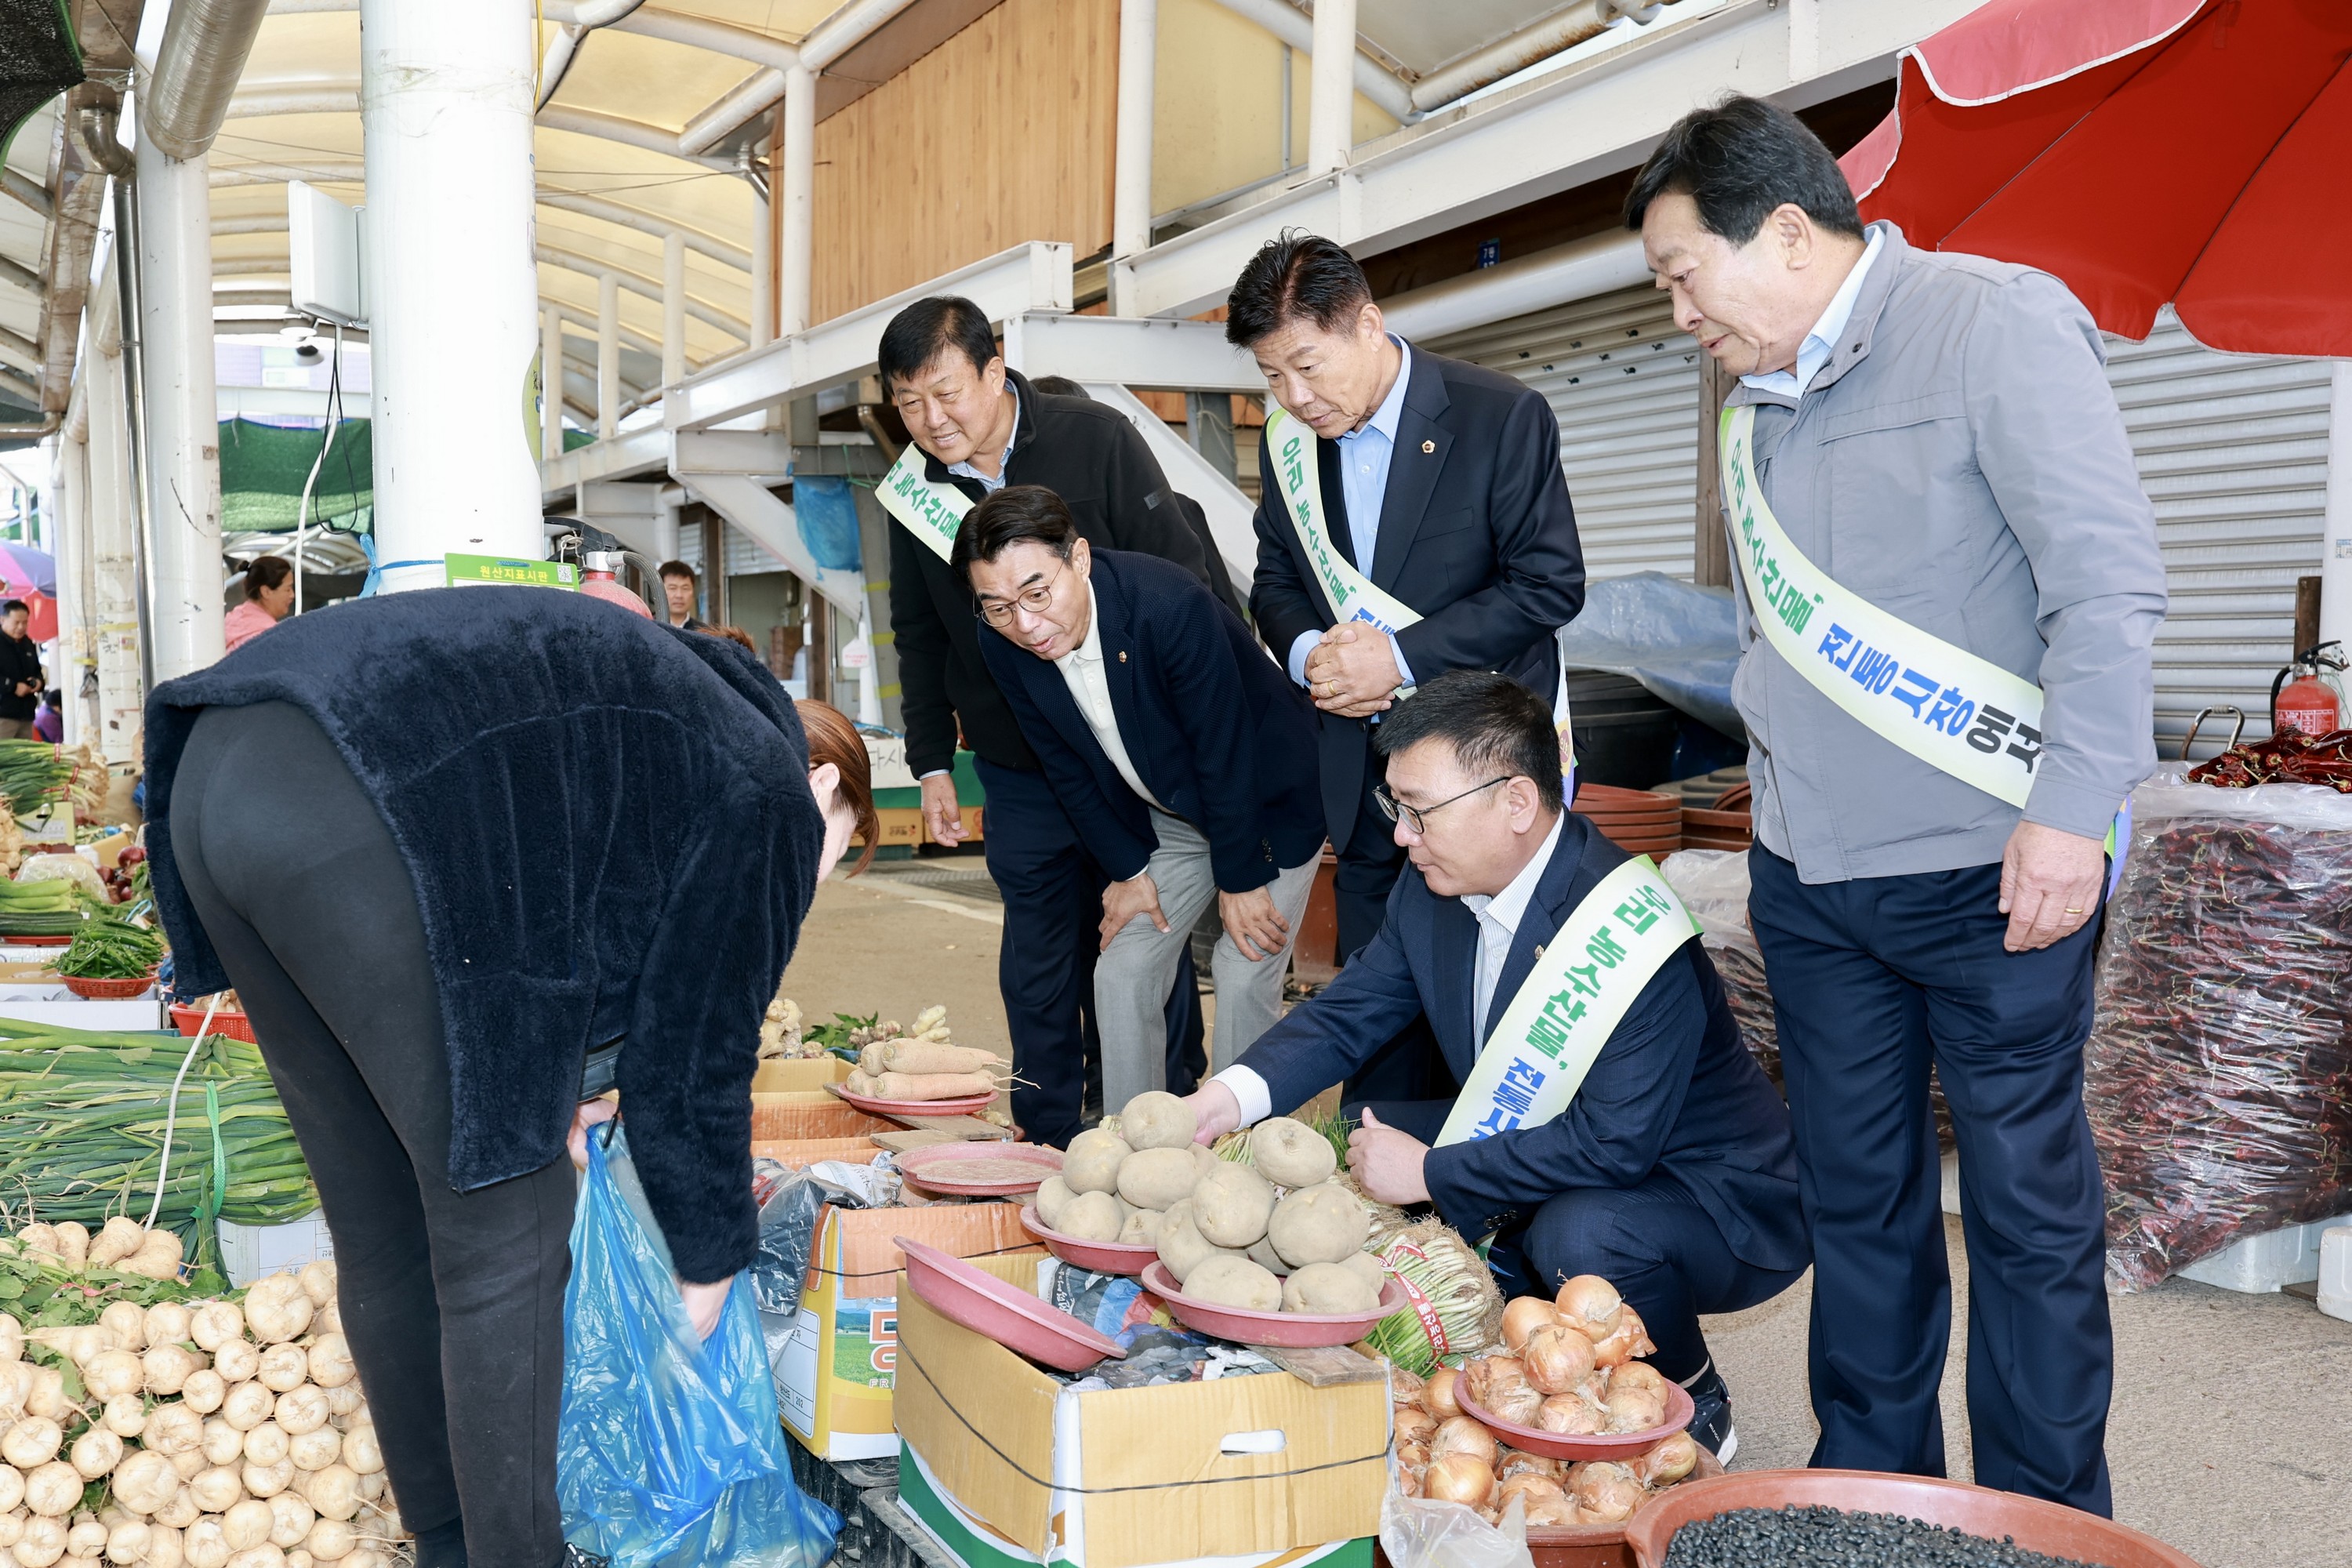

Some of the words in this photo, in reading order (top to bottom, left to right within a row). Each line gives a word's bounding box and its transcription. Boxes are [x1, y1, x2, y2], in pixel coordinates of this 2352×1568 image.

[1282, 436, 1304, 495] 우리
[1296, 499, 1357, 607] 농수산물,
[479, 565, 549, 583] 원산지표시판
[1730, 437, 1747, 510] 우리
[1741, 503, 1824, 637] 농수산물,
[1817, 622, 2043, 774] 전통시장에서
[868, 746, 908, 771] 다시
[1612, 884, 1671, 935] 우리
[1524, 925, 1628, 1070] 농수산물,
[869, 1378, 889, 1388] FR
